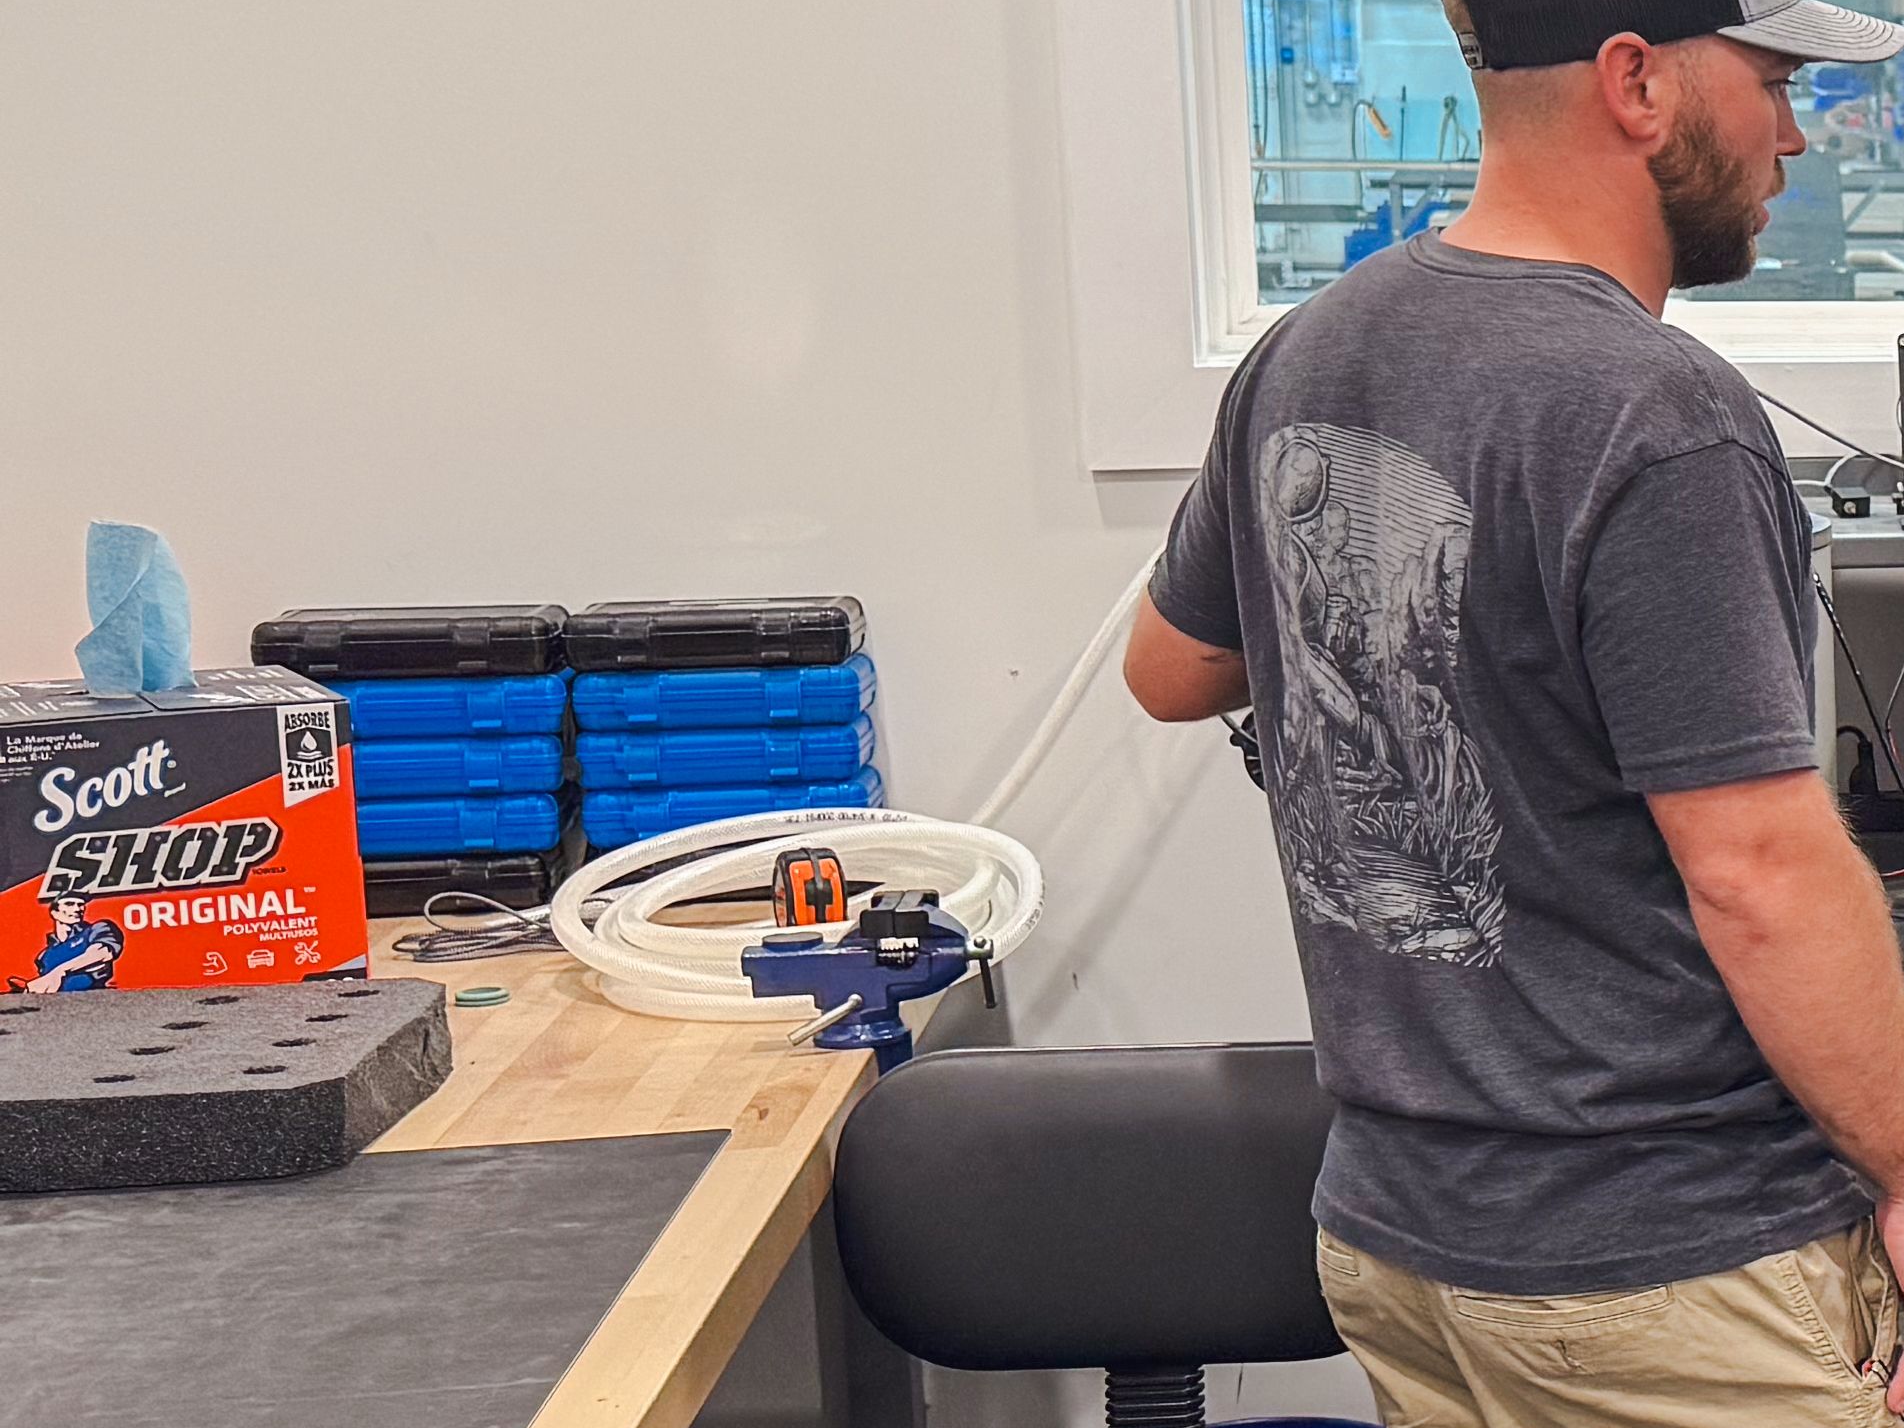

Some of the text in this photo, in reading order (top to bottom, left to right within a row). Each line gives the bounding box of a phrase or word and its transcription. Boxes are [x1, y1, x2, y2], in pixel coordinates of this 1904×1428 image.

[284, 711, 331, 732] ABSORBE
[287, 759, 334, 778] 2X PLUS
[34, 739, 170, 832] Scott
[42, 819, 277, 898] SHOP
[123, 888, 306, 931] ORIGINAL
[223, 916, 318, 937] POLYVALENT
[259, 927, 319, 942] MULTIUSOS
